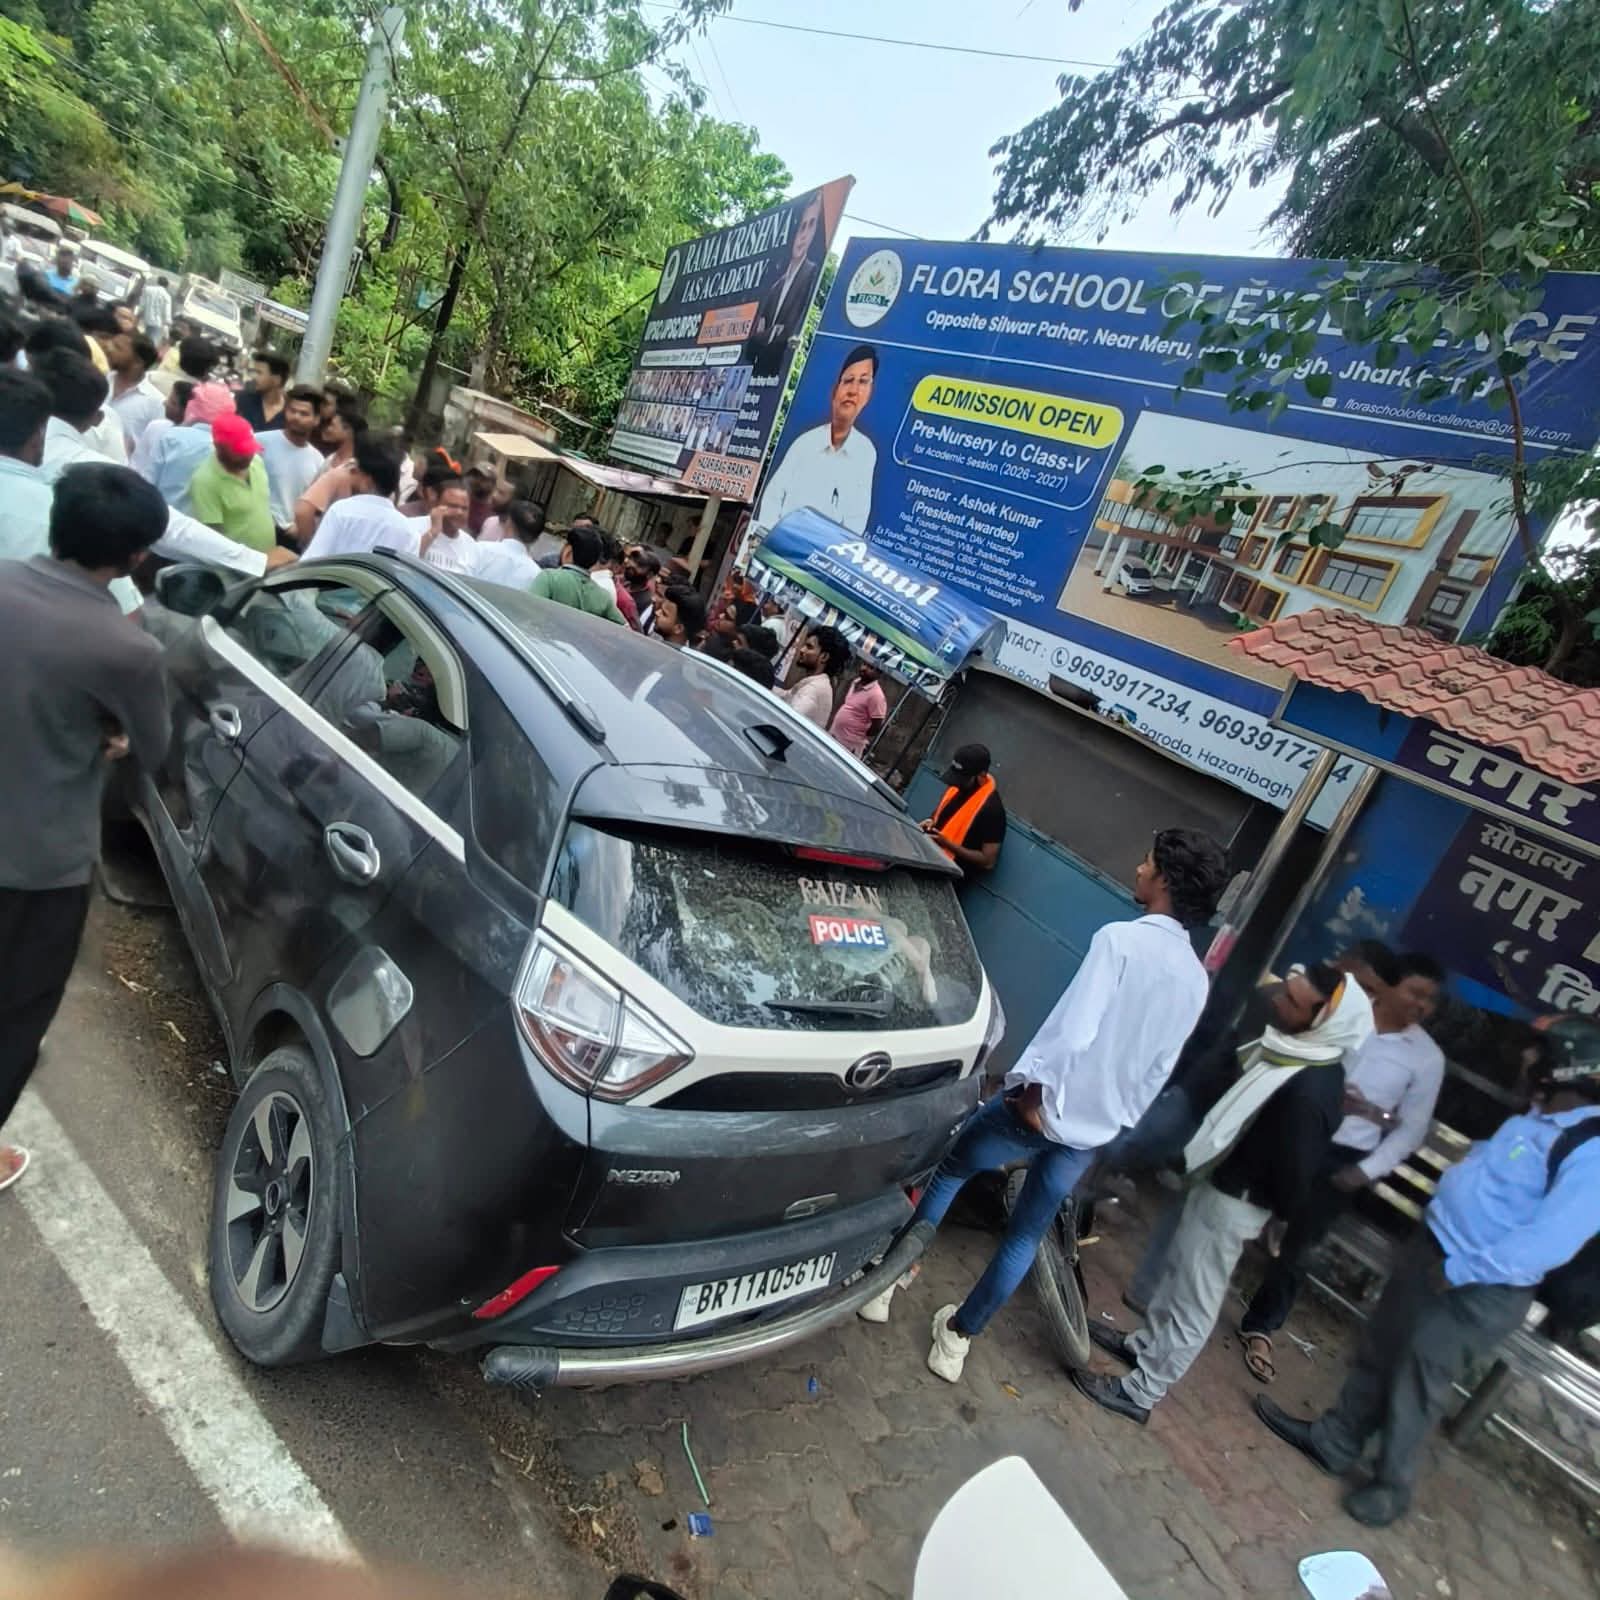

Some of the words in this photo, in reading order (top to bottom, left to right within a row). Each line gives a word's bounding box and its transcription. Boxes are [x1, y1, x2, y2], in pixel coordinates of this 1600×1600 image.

[682, 238, 722, 275] RAMA
[721, 208, 794, 266] KRISHNA
[681, 275, 702, 303] IAS
[700, 259, 769, 300] ACADEMY
[908, 264, 1001, 300] FLORA
[1008, 270, 1148, 315] SCHOOL
[926, 309, 988, 332] Opposite
[988, 315, 1036, 337] Silwar
[1037, 323, 1090, 345] Pahar,
[1093, 328, 1139, 350] Near
[1139, 336, 1194, 360] Meru,
[928, 386, 1036, 422] ADMISSION
[1039, 405, 1103, 436] OPEN
[910, 419, 998, 457] Pre-Nursery
[1000, 439, 1017, 457] to
[1021, 443, 1090, 475] Class-V
[913, 443, 924, 455] for
[925, 447, 965, 465] Academic
[967, 455, 998, 473] Session
[999, 461, 1069, 492] (2026-2027)
[907, 479, 951, 502] Director
[958, 493, 996, 518] Ashok
[998, 503, 1043, 529] Kumar
[912, 500, 966, 526] (President
[965, 516, 1019, 546] Awardee)
[807, 552, 832, 569] Real
[852, 579, 875, 598] Real
[873, 594, 889, 608] Ice
[826, 540, 940, 607] Amul
[1017, 574, 1037, 588] Zone
[1006, 631, 1042, 655] NTACT
[1199, 707, 1355, 785] 969391724
[1199, 746, 1294, 801] Hazaribagh
[1426, 730, 1597, 827] नगर
[1459, 855, 1583, 943] नगर
[815, 920, 885, 946] POLICE
[607, 1169, 681, 1186] NEXON
